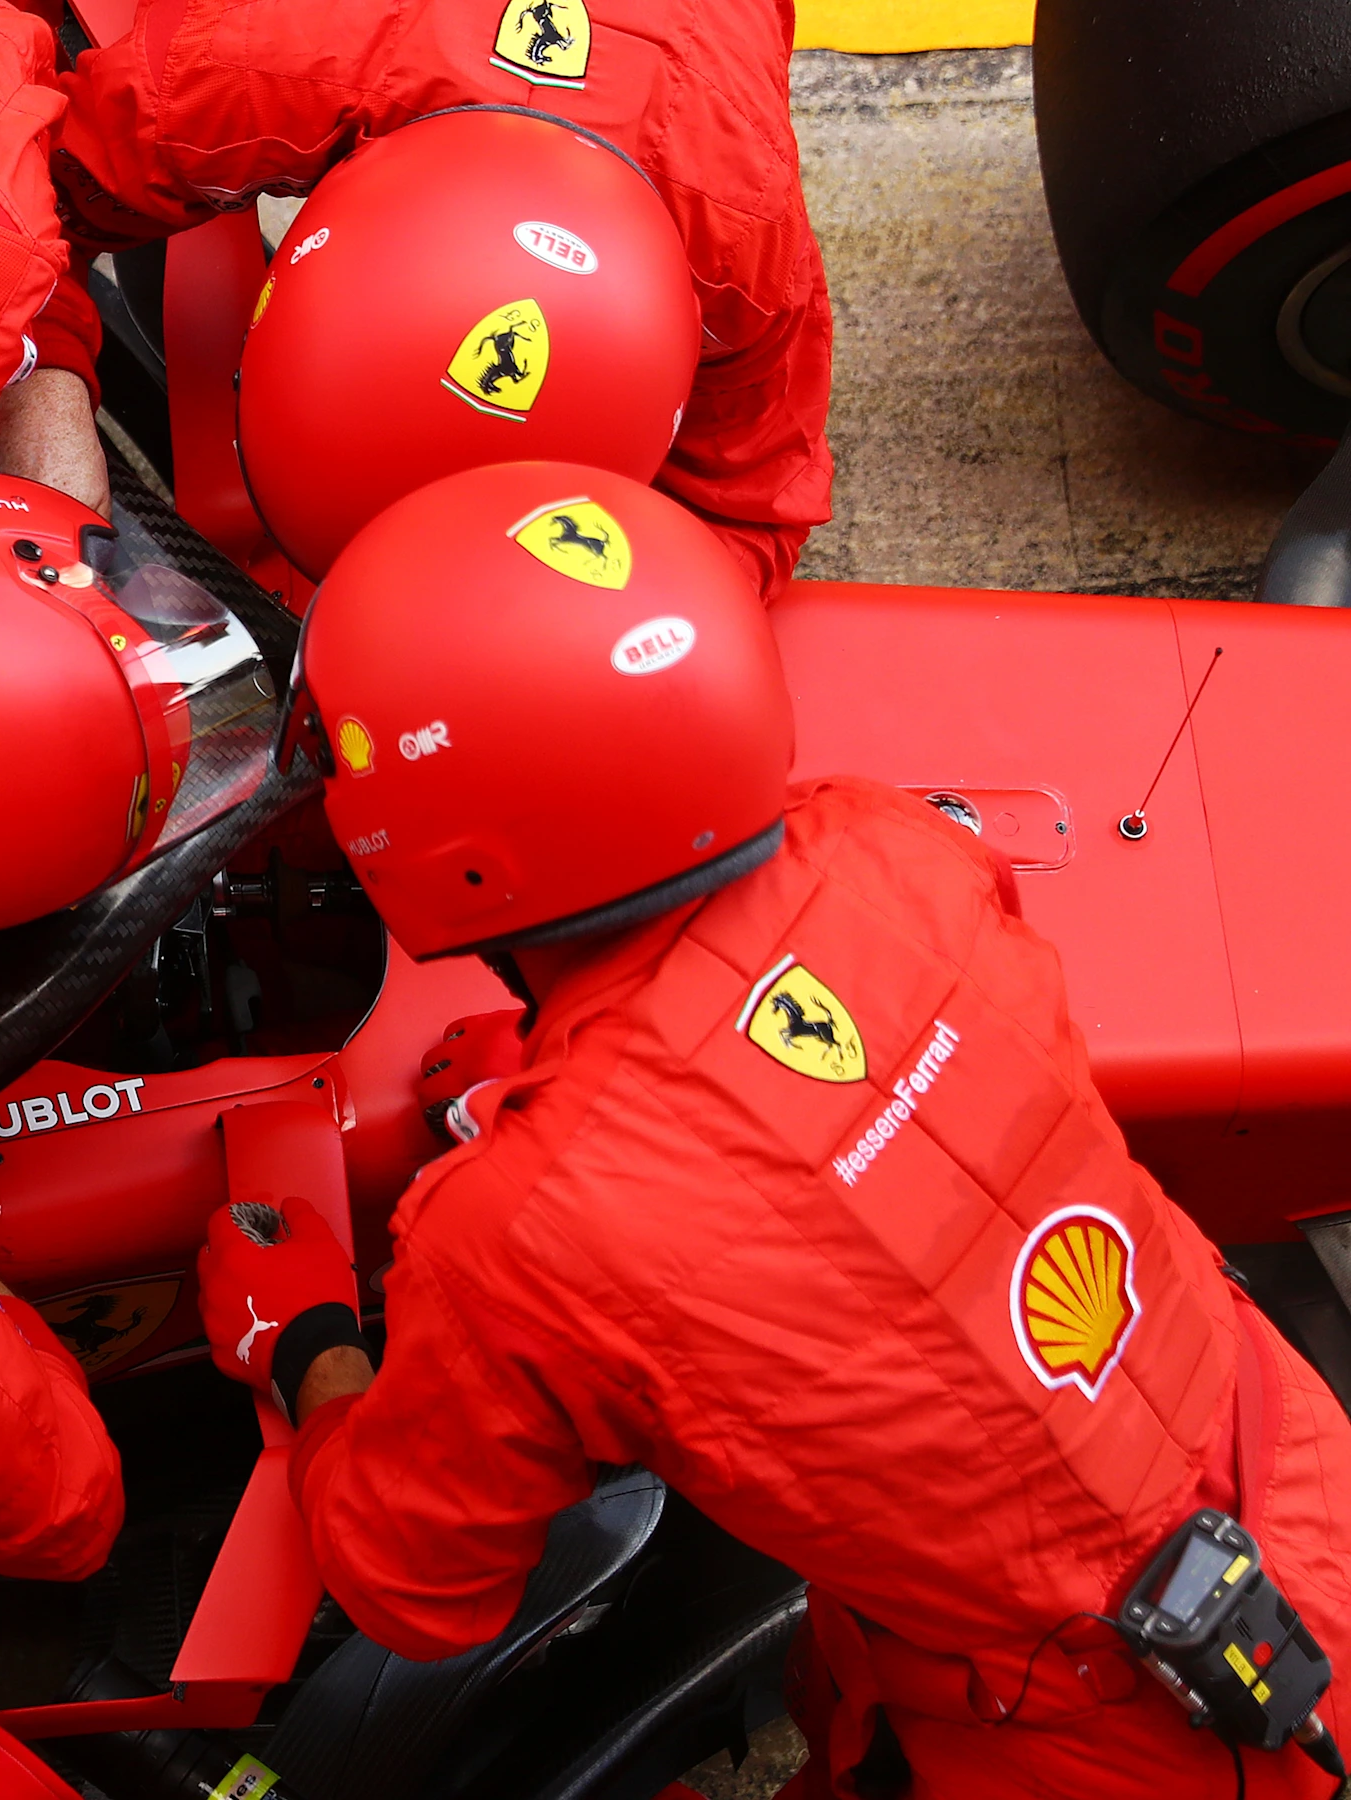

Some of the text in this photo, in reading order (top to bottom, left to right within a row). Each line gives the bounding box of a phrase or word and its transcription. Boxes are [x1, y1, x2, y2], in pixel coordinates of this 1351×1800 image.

[530, 229, 587, 268] BELL
[624, 628, 685, 666] BELL
[346, 829, 391, 857] HUBLOT
[832, 1019, 960, 1189] #essereFerrari
